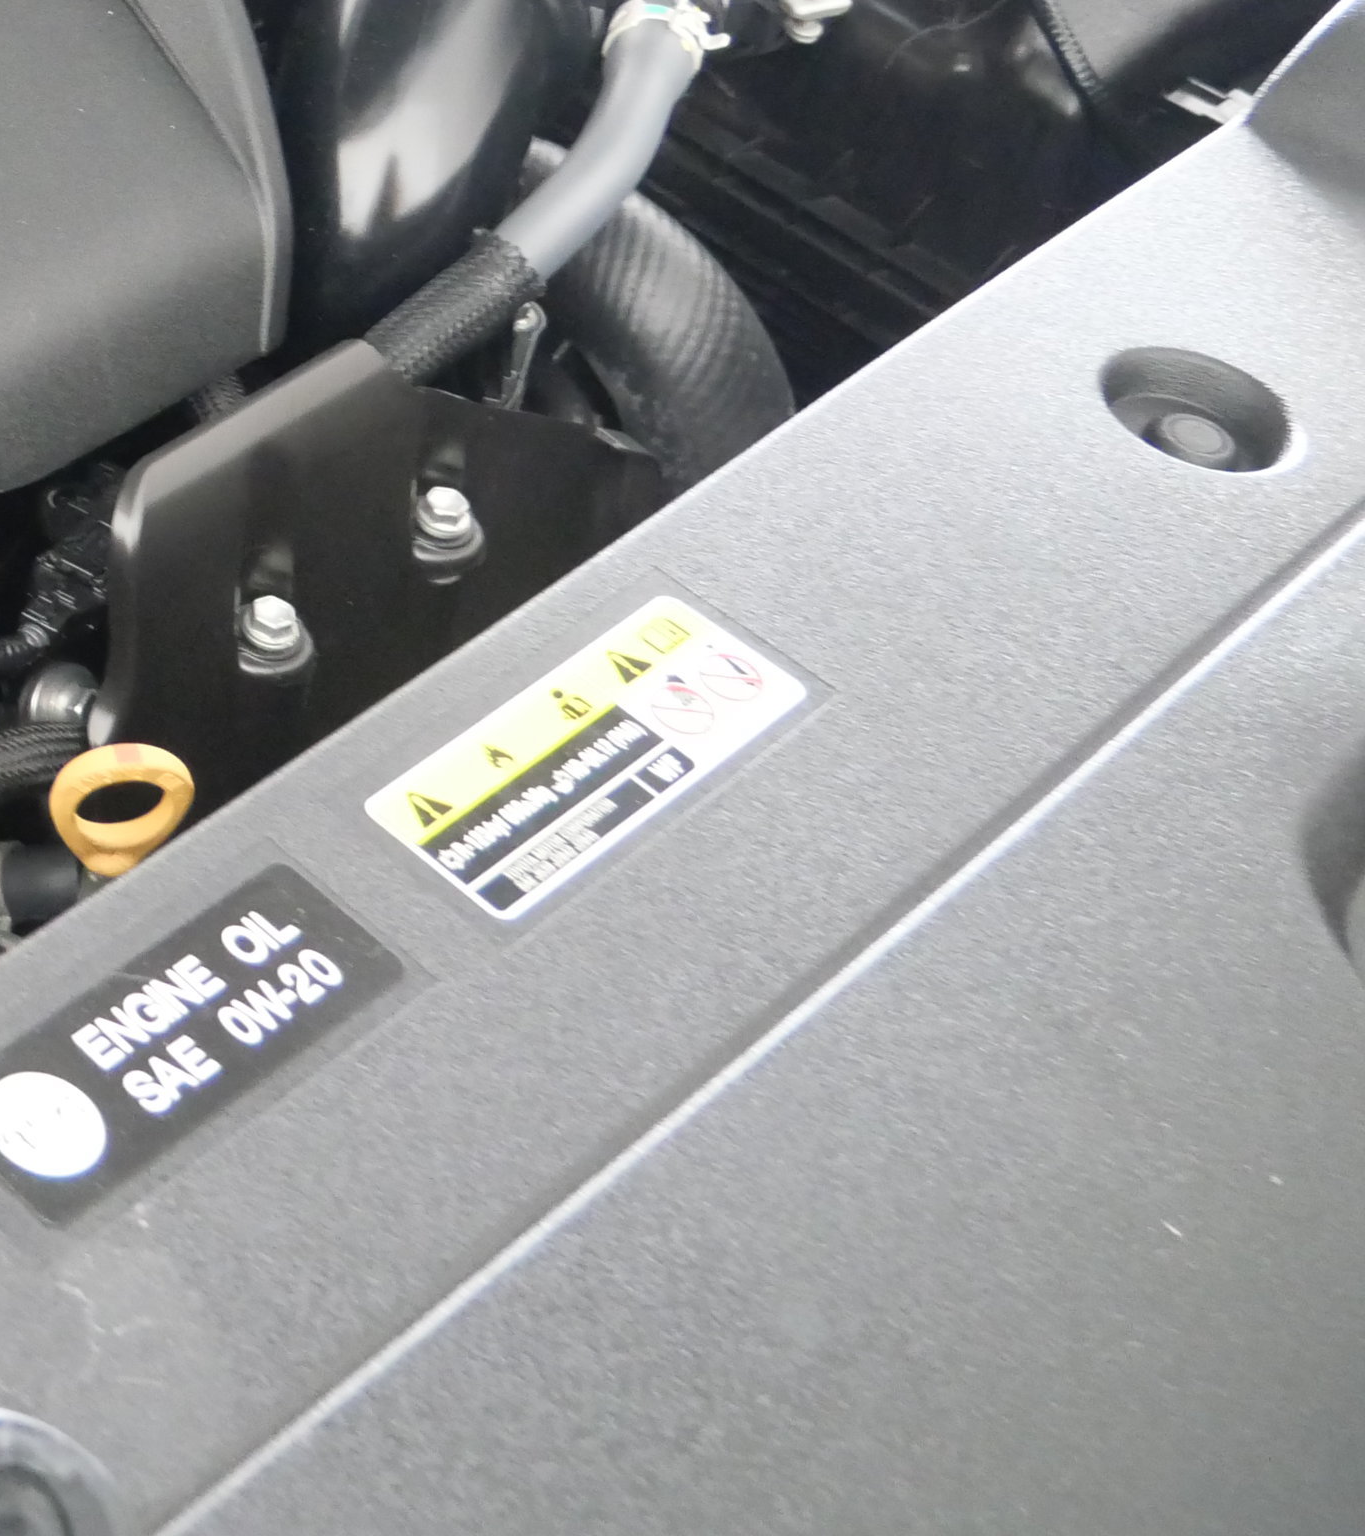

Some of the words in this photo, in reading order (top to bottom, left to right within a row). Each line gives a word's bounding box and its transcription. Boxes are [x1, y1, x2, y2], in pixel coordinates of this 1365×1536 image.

[71, 954, 226, 1072] ENGINE
[221, 910, 302, 966] OIL
[122, 1034, 222, 1114] SAE
[217, 948, 344, 1046] 0W-20
